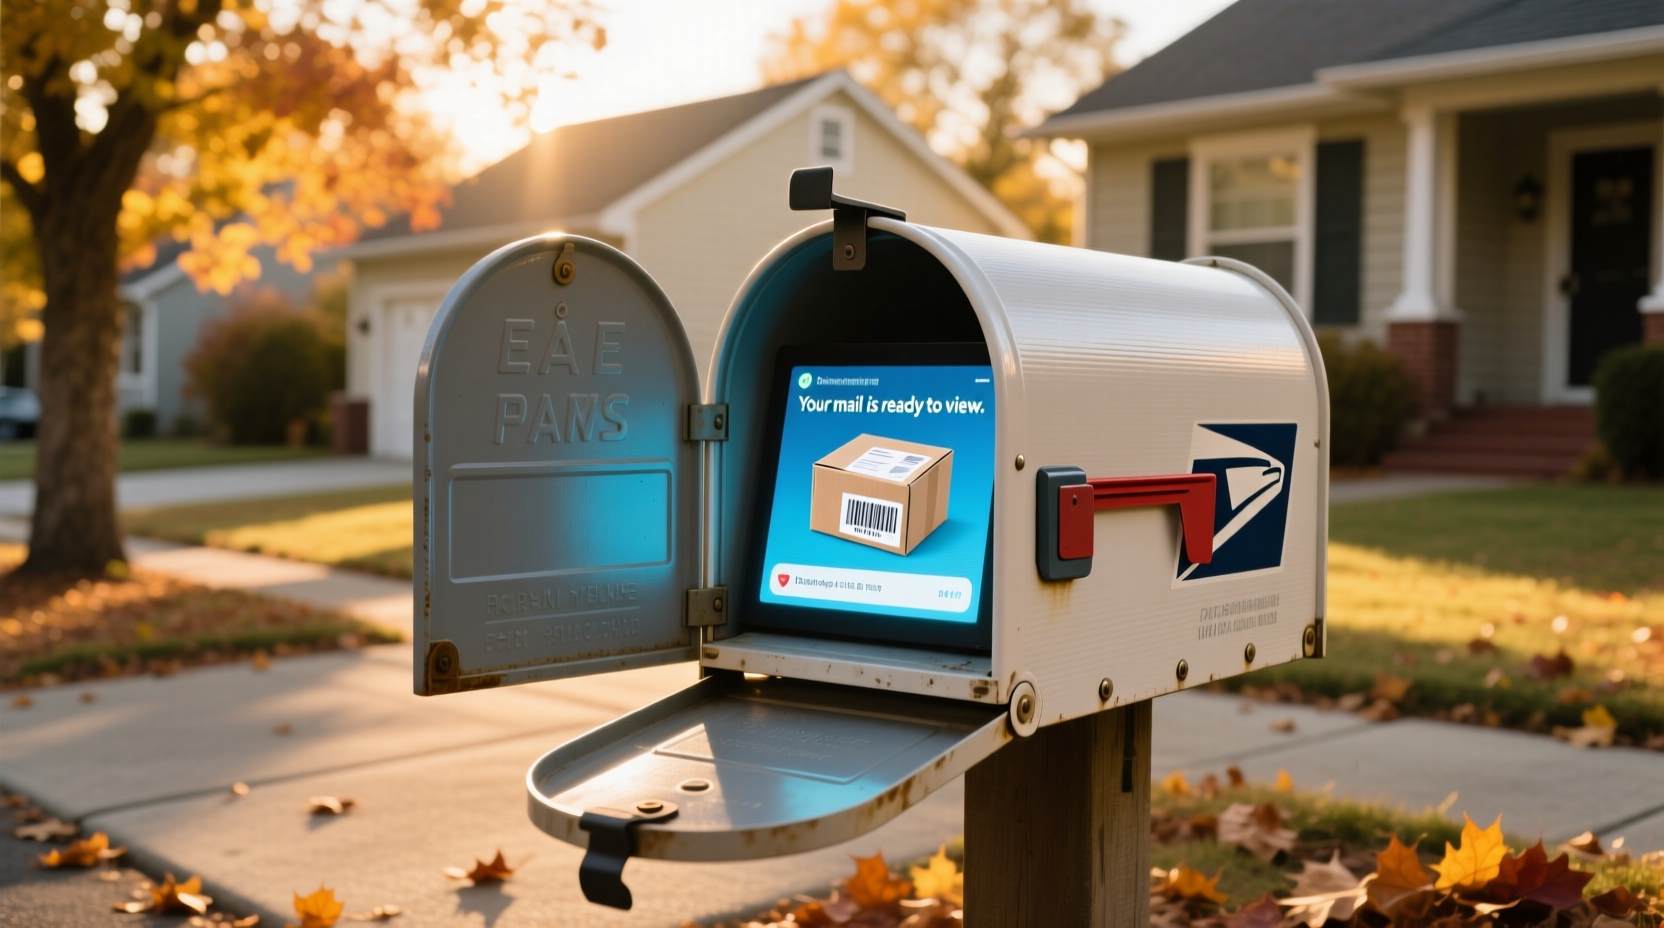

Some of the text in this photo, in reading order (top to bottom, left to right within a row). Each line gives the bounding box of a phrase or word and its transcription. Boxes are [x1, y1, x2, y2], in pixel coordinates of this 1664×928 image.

[799, 395, 985, 418] Your mail is ready to view.
